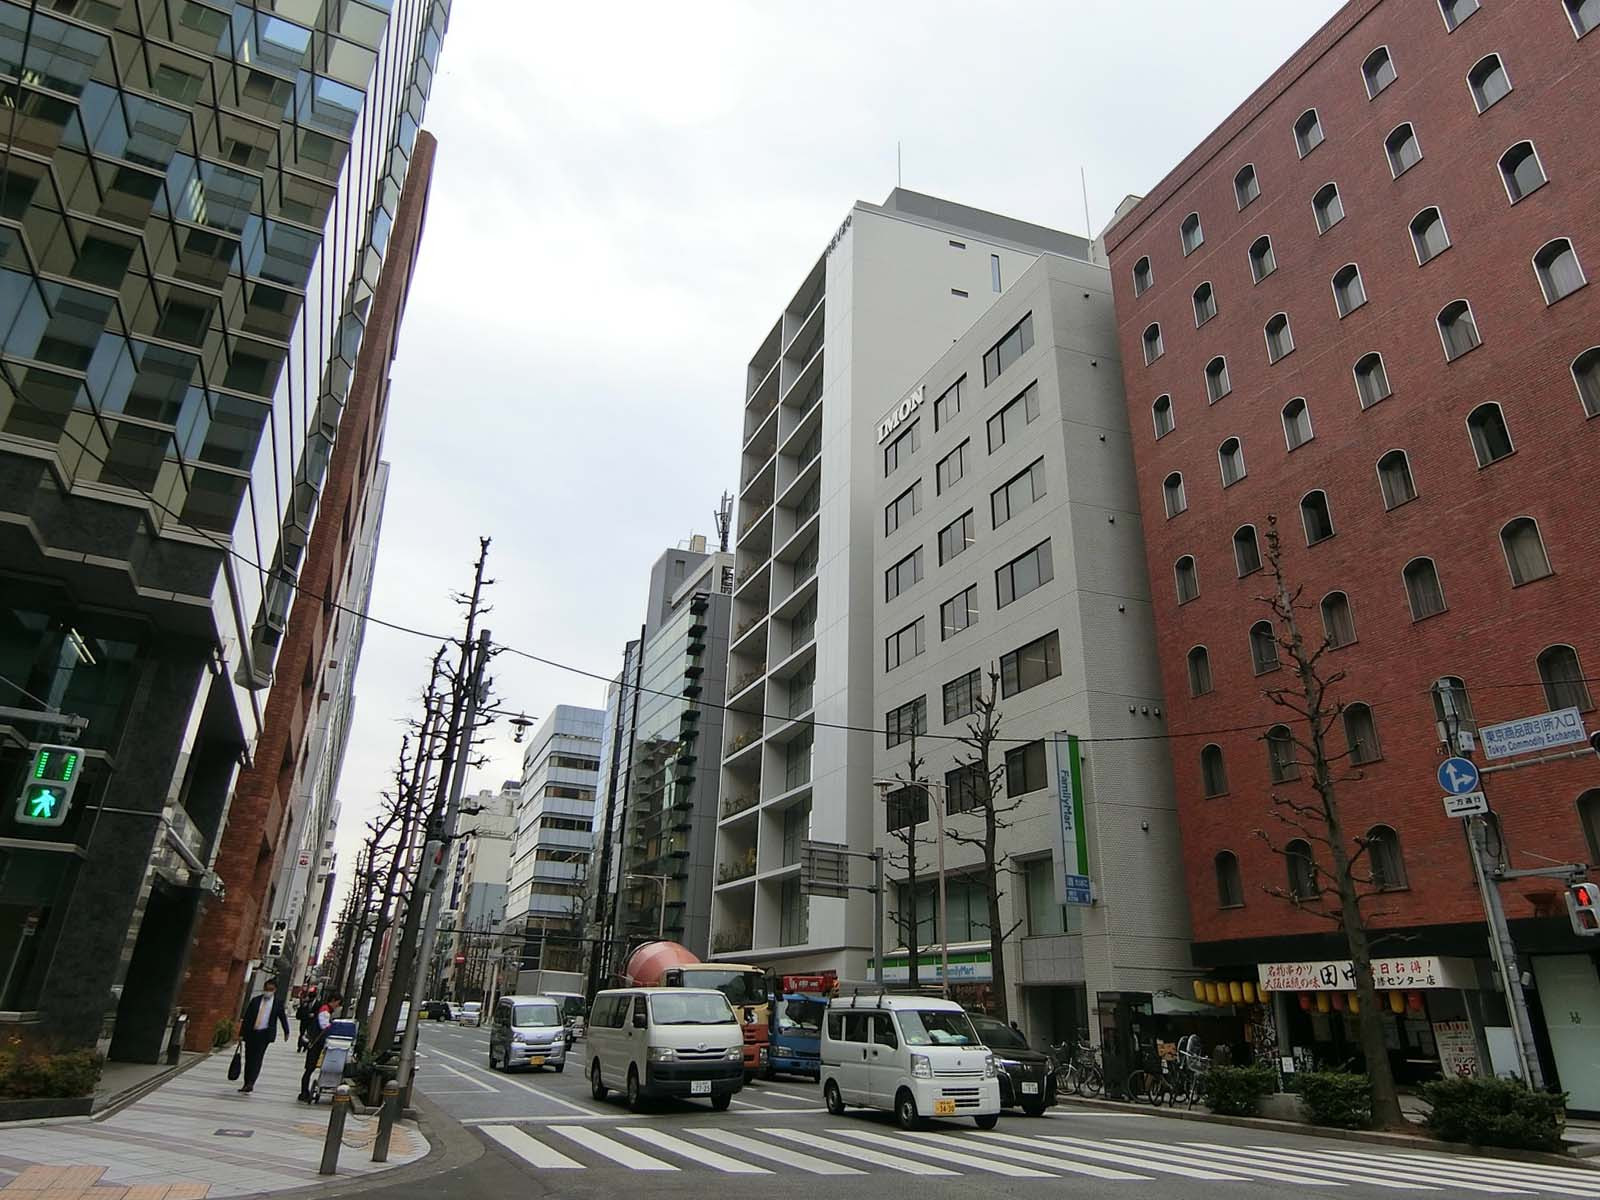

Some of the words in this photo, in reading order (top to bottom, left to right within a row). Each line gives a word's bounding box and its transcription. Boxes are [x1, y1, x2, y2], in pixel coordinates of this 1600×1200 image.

[877, 384, 925, 444] IMON
[1485, 713, 1576, 743] 東京商品取引所入口
[1488, 744, 1508, 756] Tokyo
[1507, 736, 1546, 752] Commodity
[1546, 729, 1581, 743] Exchange
[1061, 769, 1073, 831] FamilyMart
[1447, 796, 1481, 806] 一方通行
